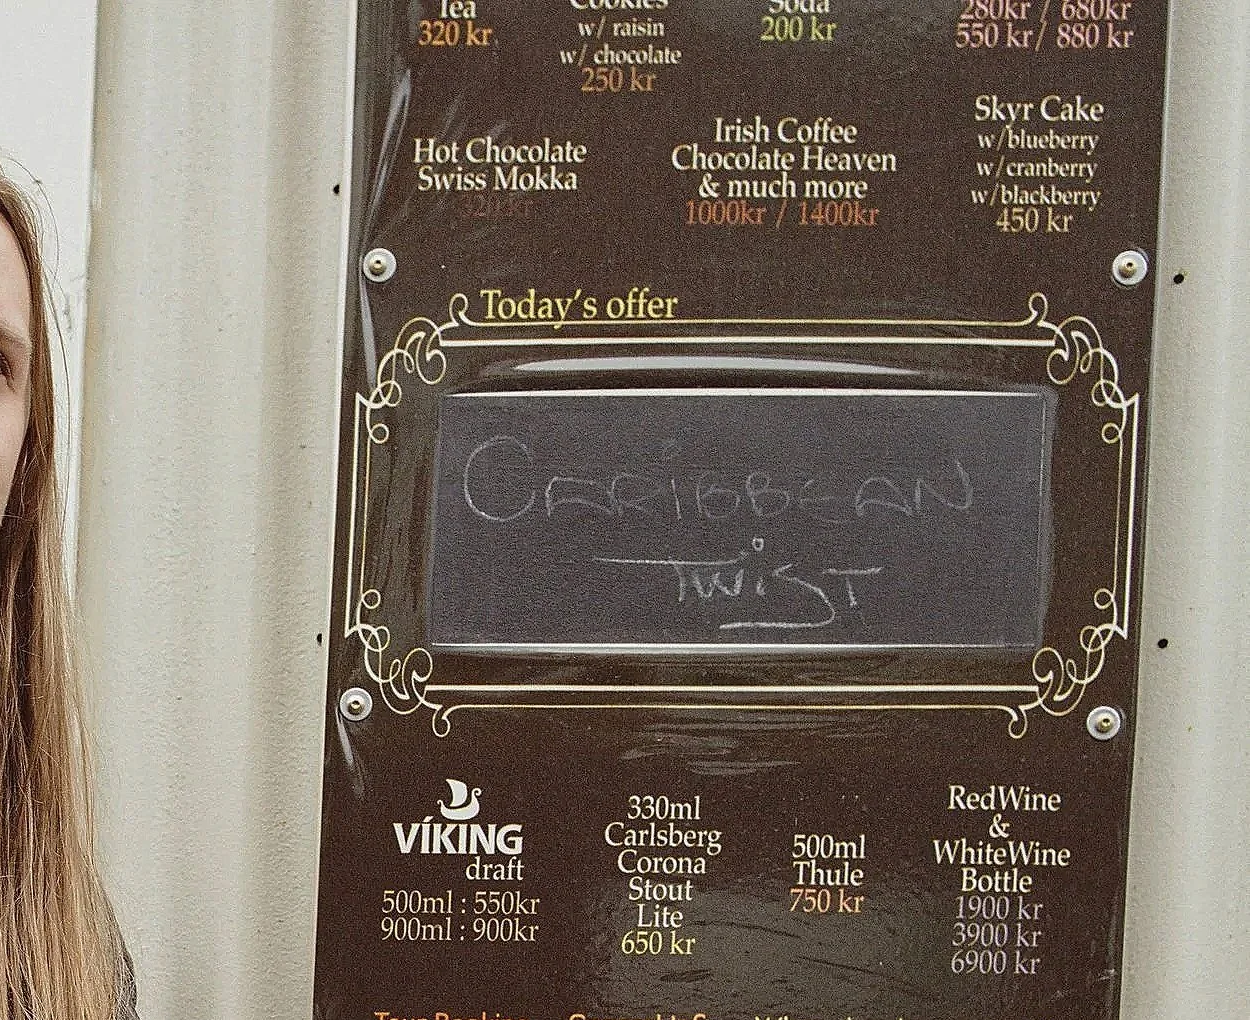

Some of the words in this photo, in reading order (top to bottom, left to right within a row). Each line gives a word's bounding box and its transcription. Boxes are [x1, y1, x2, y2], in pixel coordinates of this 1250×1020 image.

[439, 0, 478, 19] Tea
[960, 0, 1031, 20] 280kr
[1061, 0, 1132, 20] 680kr
[417, 20, 460, 46] 320
[466, 20, 493, 46] kr
[578, 15, 607, 39] w/
[612, 17, 665, 37] raisin
[759, 15, 804, 41] 200
[811, 15, 837, 41] kr
[955, 22, 1000, 48] 550
[1006, 22, 1034, 48] kr
[1056, 22, 1101, 49] 880
[1107, 23, 1135, 49] kr
[559, 43, 589, 67] w/
[593, 43, 683, 65] chocolate
[581, 67, 623, 93] 250
[630, 68, 656, 92] kr
[974, 95, 1034, 130] Skyr
[1040, 96, 1104, 123] Cake
[715, 117, 771, 144] Irish
[776, 117, 858, 144] Coffee
[413, 137, 459, 164] Hot
[465, 137, 588, 164] Chocolate
[671, 145, 794, 172] Chocolate
[801, 145, 897, 172] Heaven
[417, 165, 487, 192] Swiss
[494, 165, 578, 192] Mokka
[698, 173, 721, 199] &
[728, 172, 797, 199] much
[801, 179, 869, 199] more
[685, 201, 767, 227] 1000kr
[775, 201, 786, 229] /
[798, 201, 880, 227] 1400kr
[995, 207, 1040, 233] 450
[1046, 208, 1074, 233] kr
[480, 288, 599, 328] Today's
[605, 287, 679, 319] offer
[627, 795, 701, 821] 330ml
[948, 785, 1063, 812] RedWine
[393, 816, 524, 855] VÍKING
[604, 821, 723, 856] Carlsberg
[988, 813, 1011, 839] &
[791, 834, 867, 860] 500ml
[932, 839, 1072, 867] WhiteWine
[465, 857, 526, 882] draft
[616, 848, 707, 875] Corona
[793, 861, 865, 887] Thule
[627, 876, 694, 902] Stout
[960, 867, 1033, 894] Bottle
[380, 890, 453, 915] 500ml
[472, 891, 540, 916] 550kr
[789, 888, 832, 914] 750
[838, 888, 865, 914] kr
[954, 895, 1010, 921] 1900
[1017, 895, 1044, 921] kr
[636, 902, 685, 929] Lite
[380, 917, 453, 943] 900ml
[472, 918, 540, 943] 900kr
[621, 930, 663, 955] 650
[669, 931, 696, 956] kr
[951, 923, 1009, 948] 3900
[1015, 923, 1043, 948] kr
[950, 950, 1007, 975] 6900
[1013, 950, 1042, 975] kr
